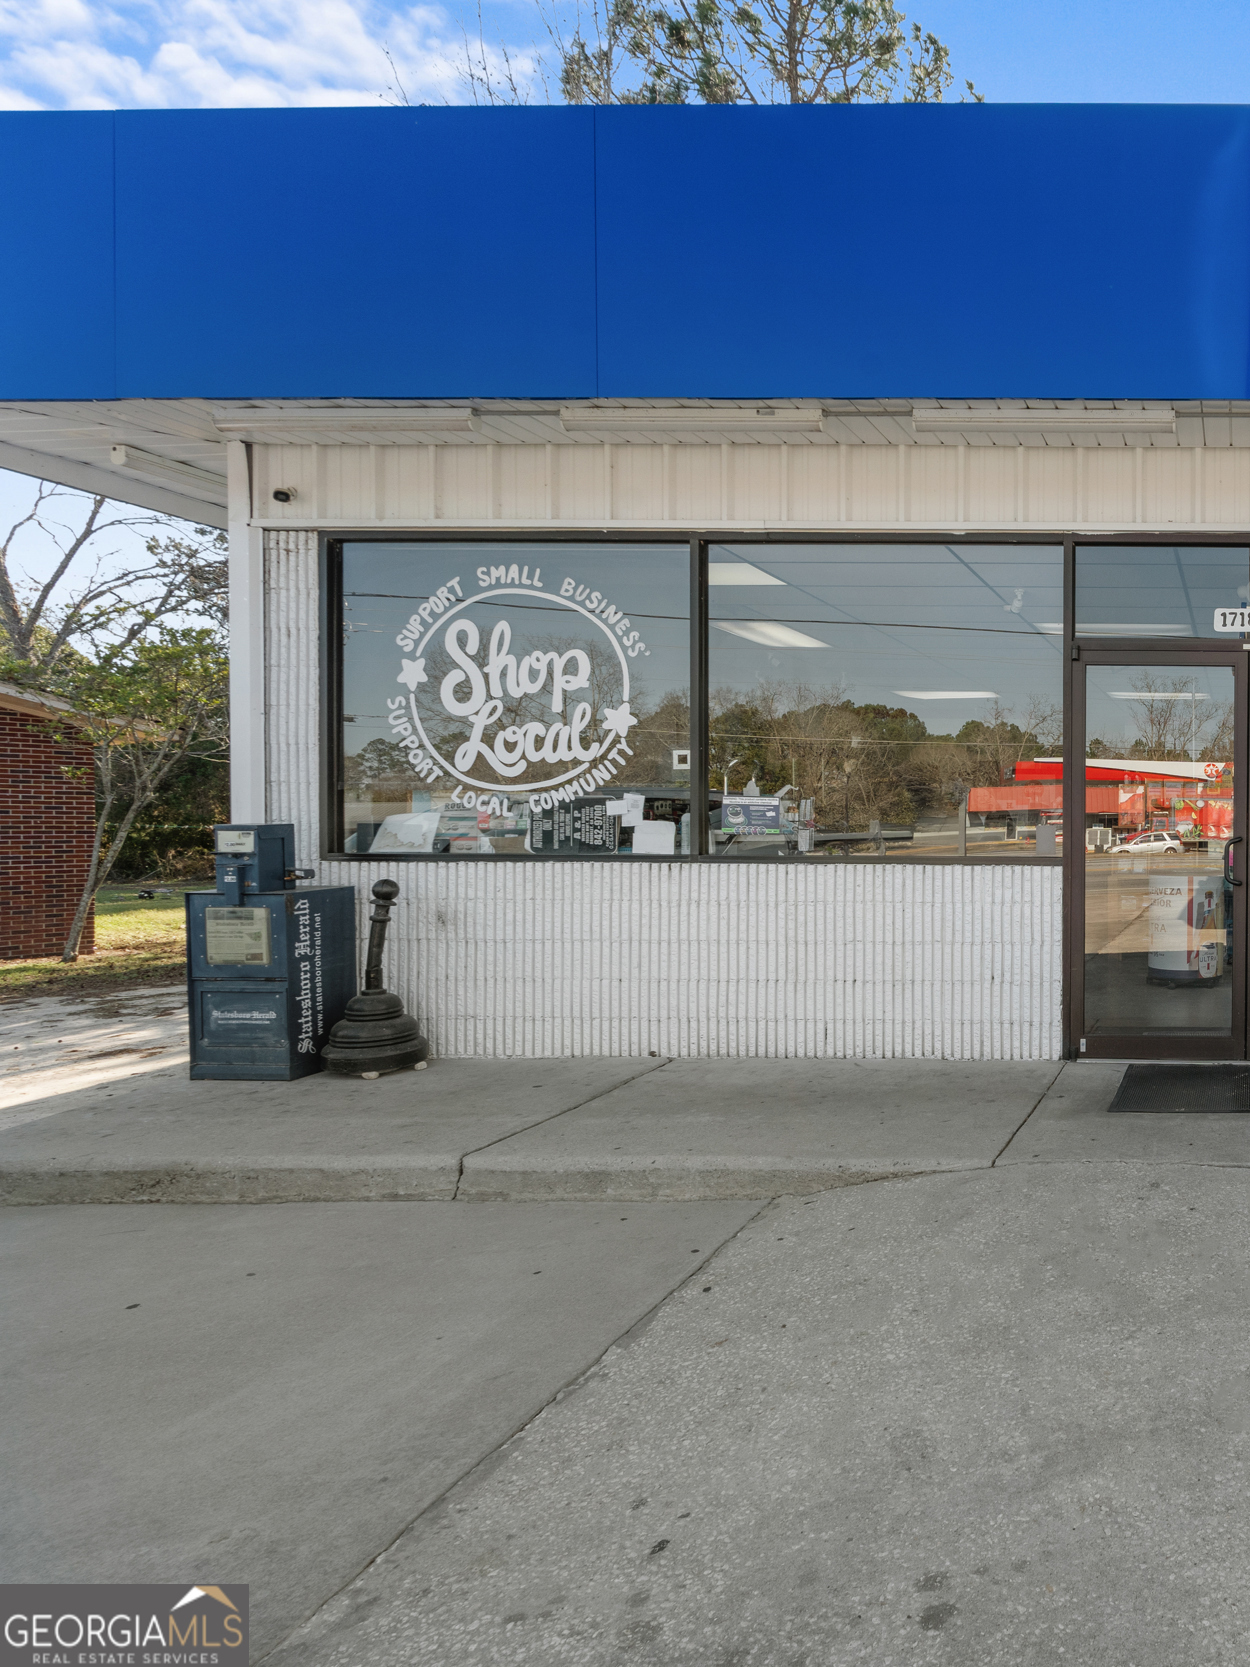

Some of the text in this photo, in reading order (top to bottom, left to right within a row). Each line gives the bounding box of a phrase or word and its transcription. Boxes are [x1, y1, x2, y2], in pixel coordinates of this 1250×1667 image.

[396, 577, 464, 652] SUPPORT
[476, 564, 543, 588] SMALL
[440, 618, 591, 716] Shop
[387, 696, 634, 817] SUPPORT LOCAL COMMUNITY
[455, 699, 600, 778] Local
[594, 805, 603, 846] 842-9700
[293, 898, 317, 1054] Statesboro Herald
[314, 912, 324, 1036] www.statesboroherald.net
